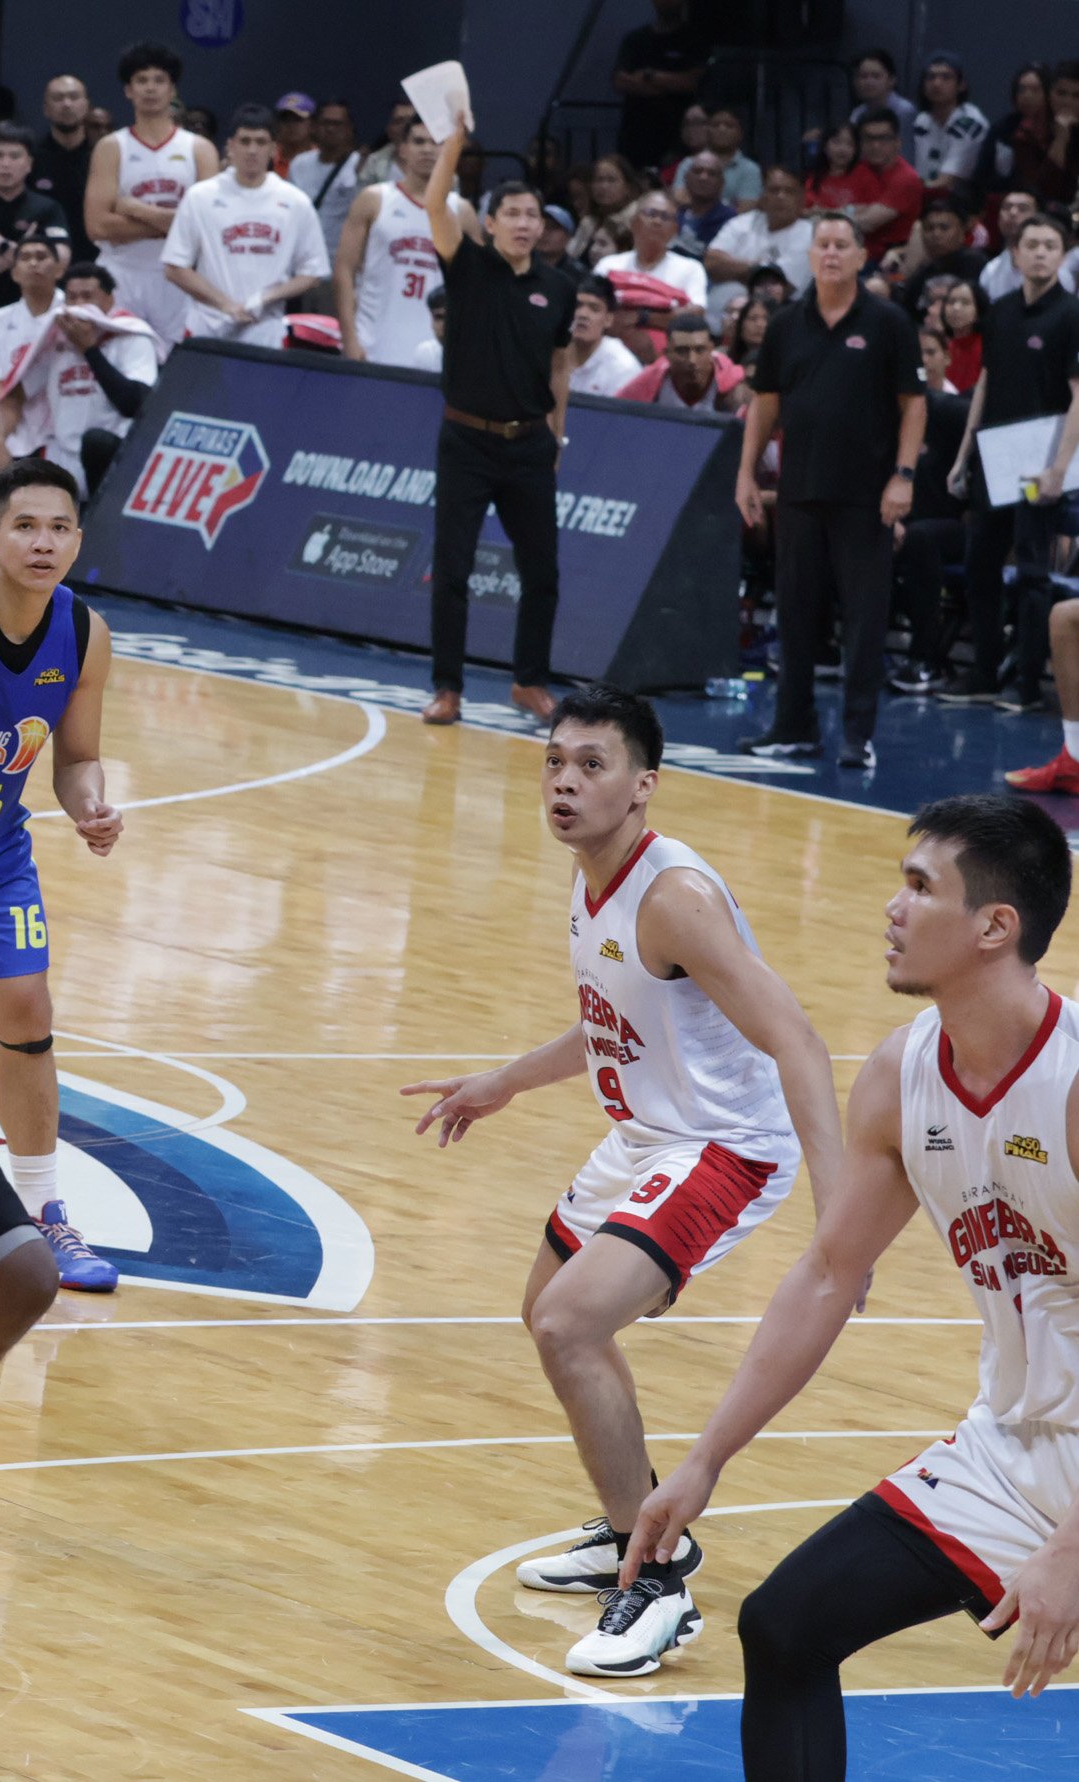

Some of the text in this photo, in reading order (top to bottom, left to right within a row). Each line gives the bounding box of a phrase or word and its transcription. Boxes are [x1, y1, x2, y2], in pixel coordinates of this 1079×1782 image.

[402, 271, 425, 299] 31
[130, 452, 227, 523] LIVE
[282, 450, 437, 505] DOWNLOAD AND
[568, 494, 638, 538] FREE!
[324, 544, 399, 578] App Store
[10, 904, 46, 949] 16
[597, 1066, 634, 1122] 9
[629, 1173, 672, 1204] 9
[948, 1198, 1067, 1268] GINEBRA
